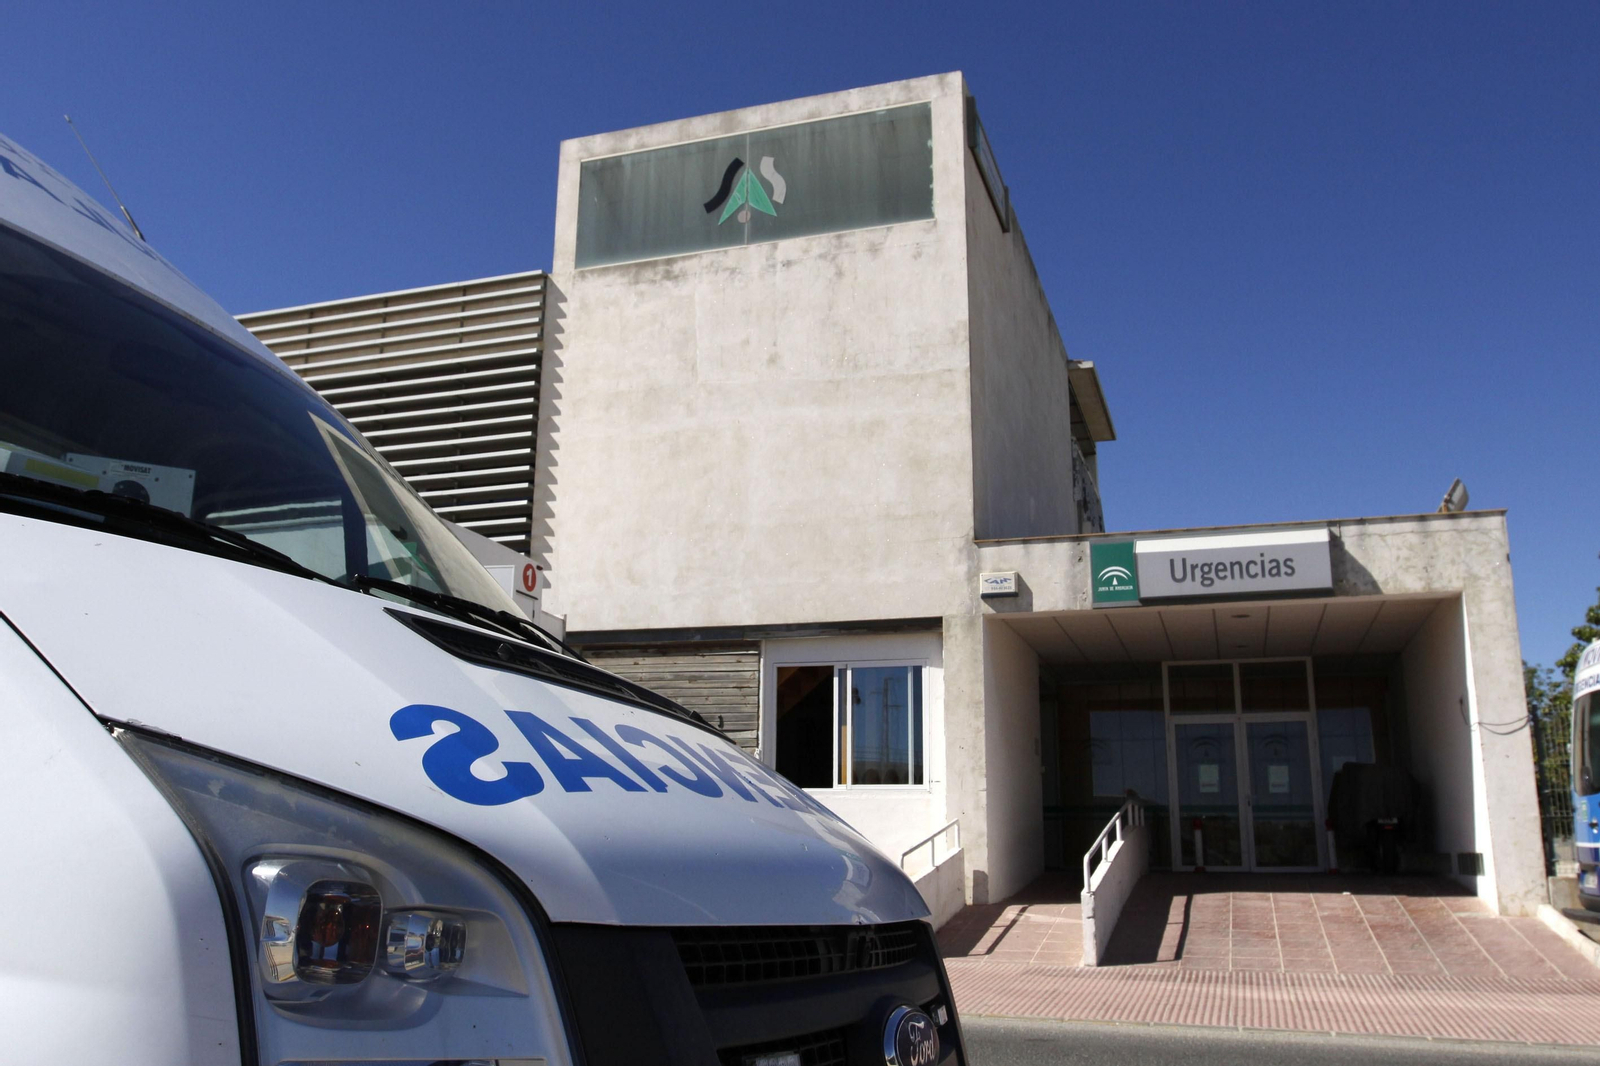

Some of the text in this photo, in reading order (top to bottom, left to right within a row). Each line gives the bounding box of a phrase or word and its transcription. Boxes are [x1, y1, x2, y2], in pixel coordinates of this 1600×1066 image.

[526, 568, 533, 587] 1
[1169, 552, 1296, 588] Urgencias
[908, 1021, 936, 1066] Ford
